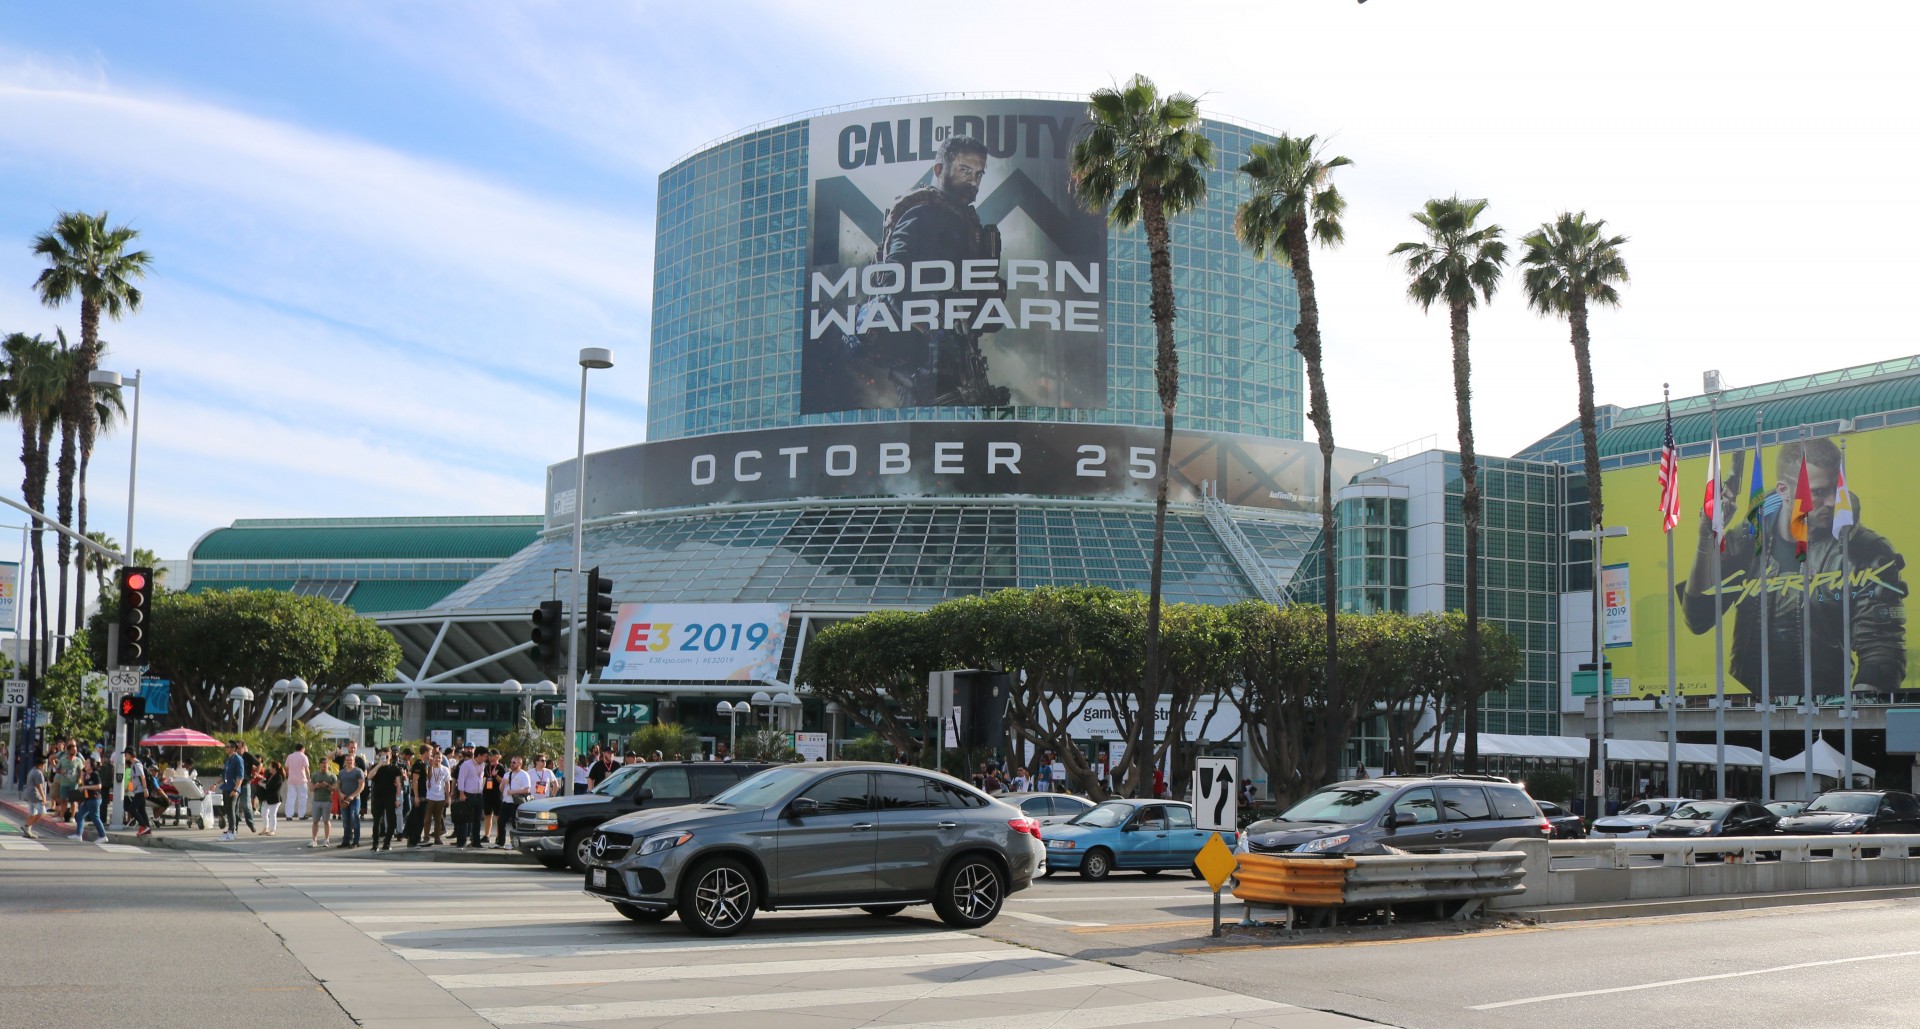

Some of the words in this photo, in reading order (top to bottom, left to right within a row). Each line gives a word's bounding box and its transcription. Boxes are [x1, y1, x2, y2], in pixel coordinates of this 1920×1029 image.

[837, 116, 938, 170] CALL
[935, 125, 951, 142] OF
[953, 114, 1076, 160] DUTY
[810, 259, 1099, 302] MODERN
[809, 297, 1100, 340] WARFARE
[690, 441, 1021, 485] OCTOBER
[1076, 444, 1157, 480] 25
[1605, 589, 1626, 607] E3
[1606, 606, 1627, 617] 2019
[625, 623, 674, 652] E3
[680, 622, 769, 652] 2019
[649, 657, 693, 665] E3Expo.com
[6, 693, 24, 704] 30
